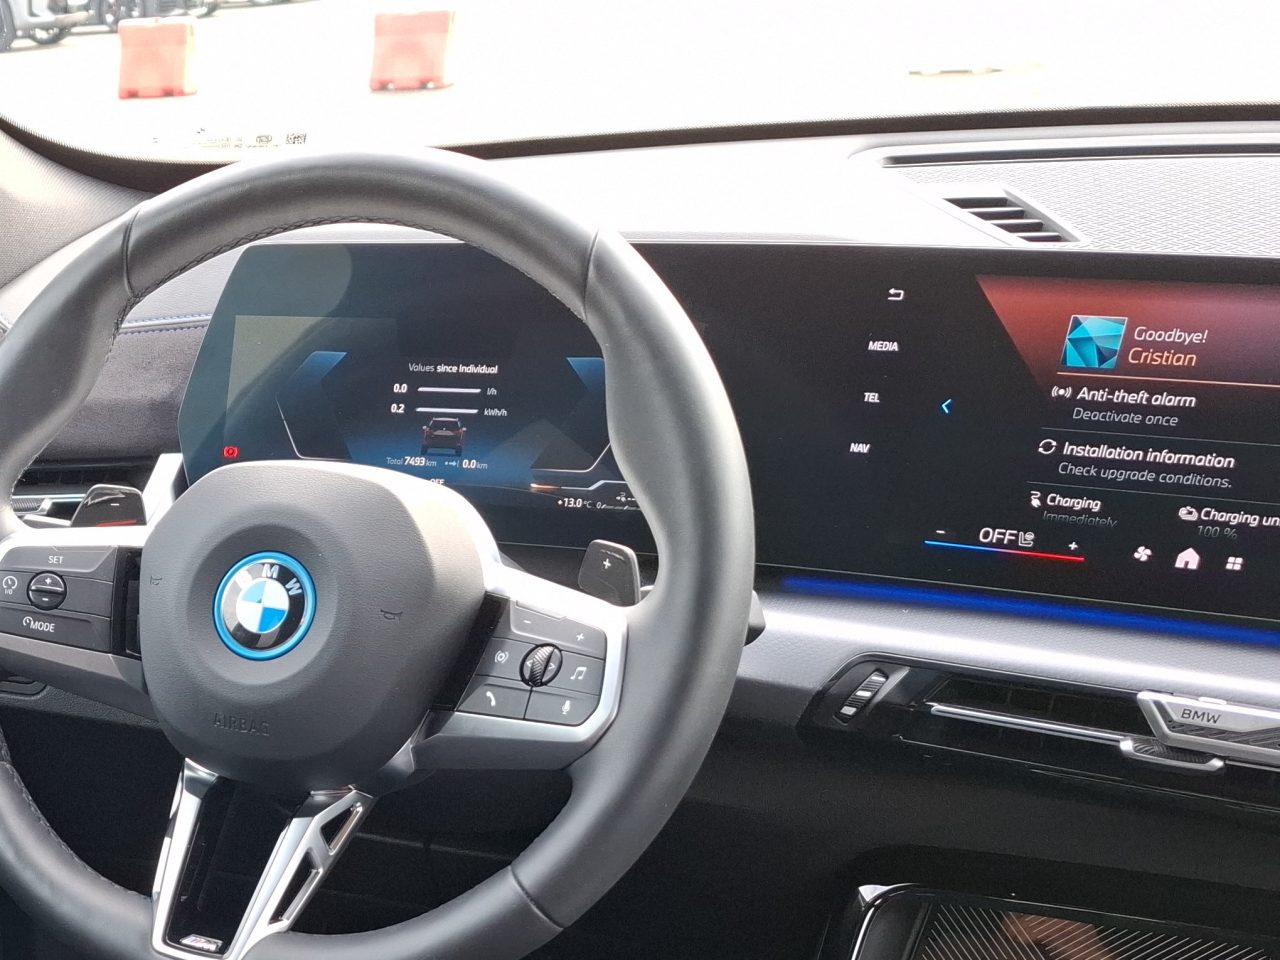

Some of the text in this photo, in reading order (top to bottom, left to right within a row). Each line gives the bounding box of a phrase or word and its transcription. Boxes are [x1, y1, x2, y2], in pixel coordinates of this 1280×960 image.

[1134, 326, 1208, 346] Goodbye!
[868, 341, 899, 351] MEDIA
[1128, 347, 1197, 367] Cristian
[408, 363, 499, 374] Values since Individual
[393, 383, 408, 393] 0.0
[863, 392, 881, 403] TEL
[1077, 386, 1197, 407] Anti-theft alarm
[390, 403, 508, 417] 0.2 kWh/h
[1072, 407, 1179, 426] Deactivate once
[849, 442, 871, 453] NAV
[1062, 441, 1236, 469] Installation information
[386, 456, 437, 467] Total 7493 km
[462, 459, 488, 470] 0.0 km
[1058, 462, 1232, 489] Check upgrade conditions.
[1046, 493, 1102, 512] Charging
[1042, 511, 1118, 528] Immediately
[1200, 507, 1260, 528] Charging
[979, 527, 1018, 545] OFF
[1197, 525, 1238, 540] 100 %
[48, 555, 64, 564] SET
[30, 621, 56, 633] MODE
[1181, 708, 1221, 724] BMW
[213, 713, 270, 736] AIRBAG
